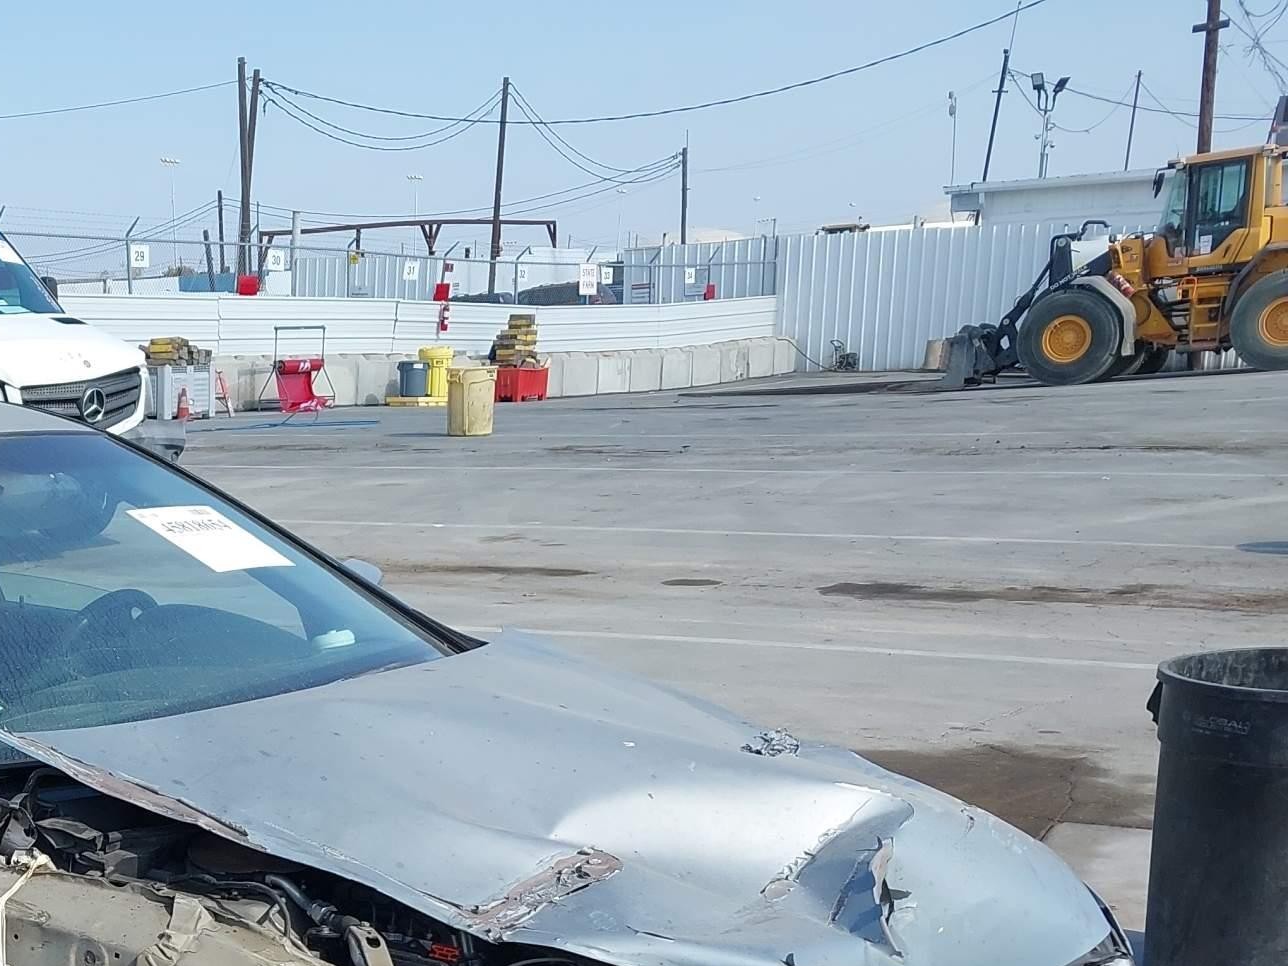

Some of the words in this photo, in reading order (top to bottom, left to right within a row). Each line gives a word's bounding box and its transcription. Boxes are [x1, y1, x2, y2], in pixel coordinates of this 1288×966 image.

[134, 250, 145, 262] 29
[271, 255, 281, 266] 30
[406, 265, 415, 276] 31
[519, 269, 526, 279] 32
[582, 268, 595, 277] STATE
